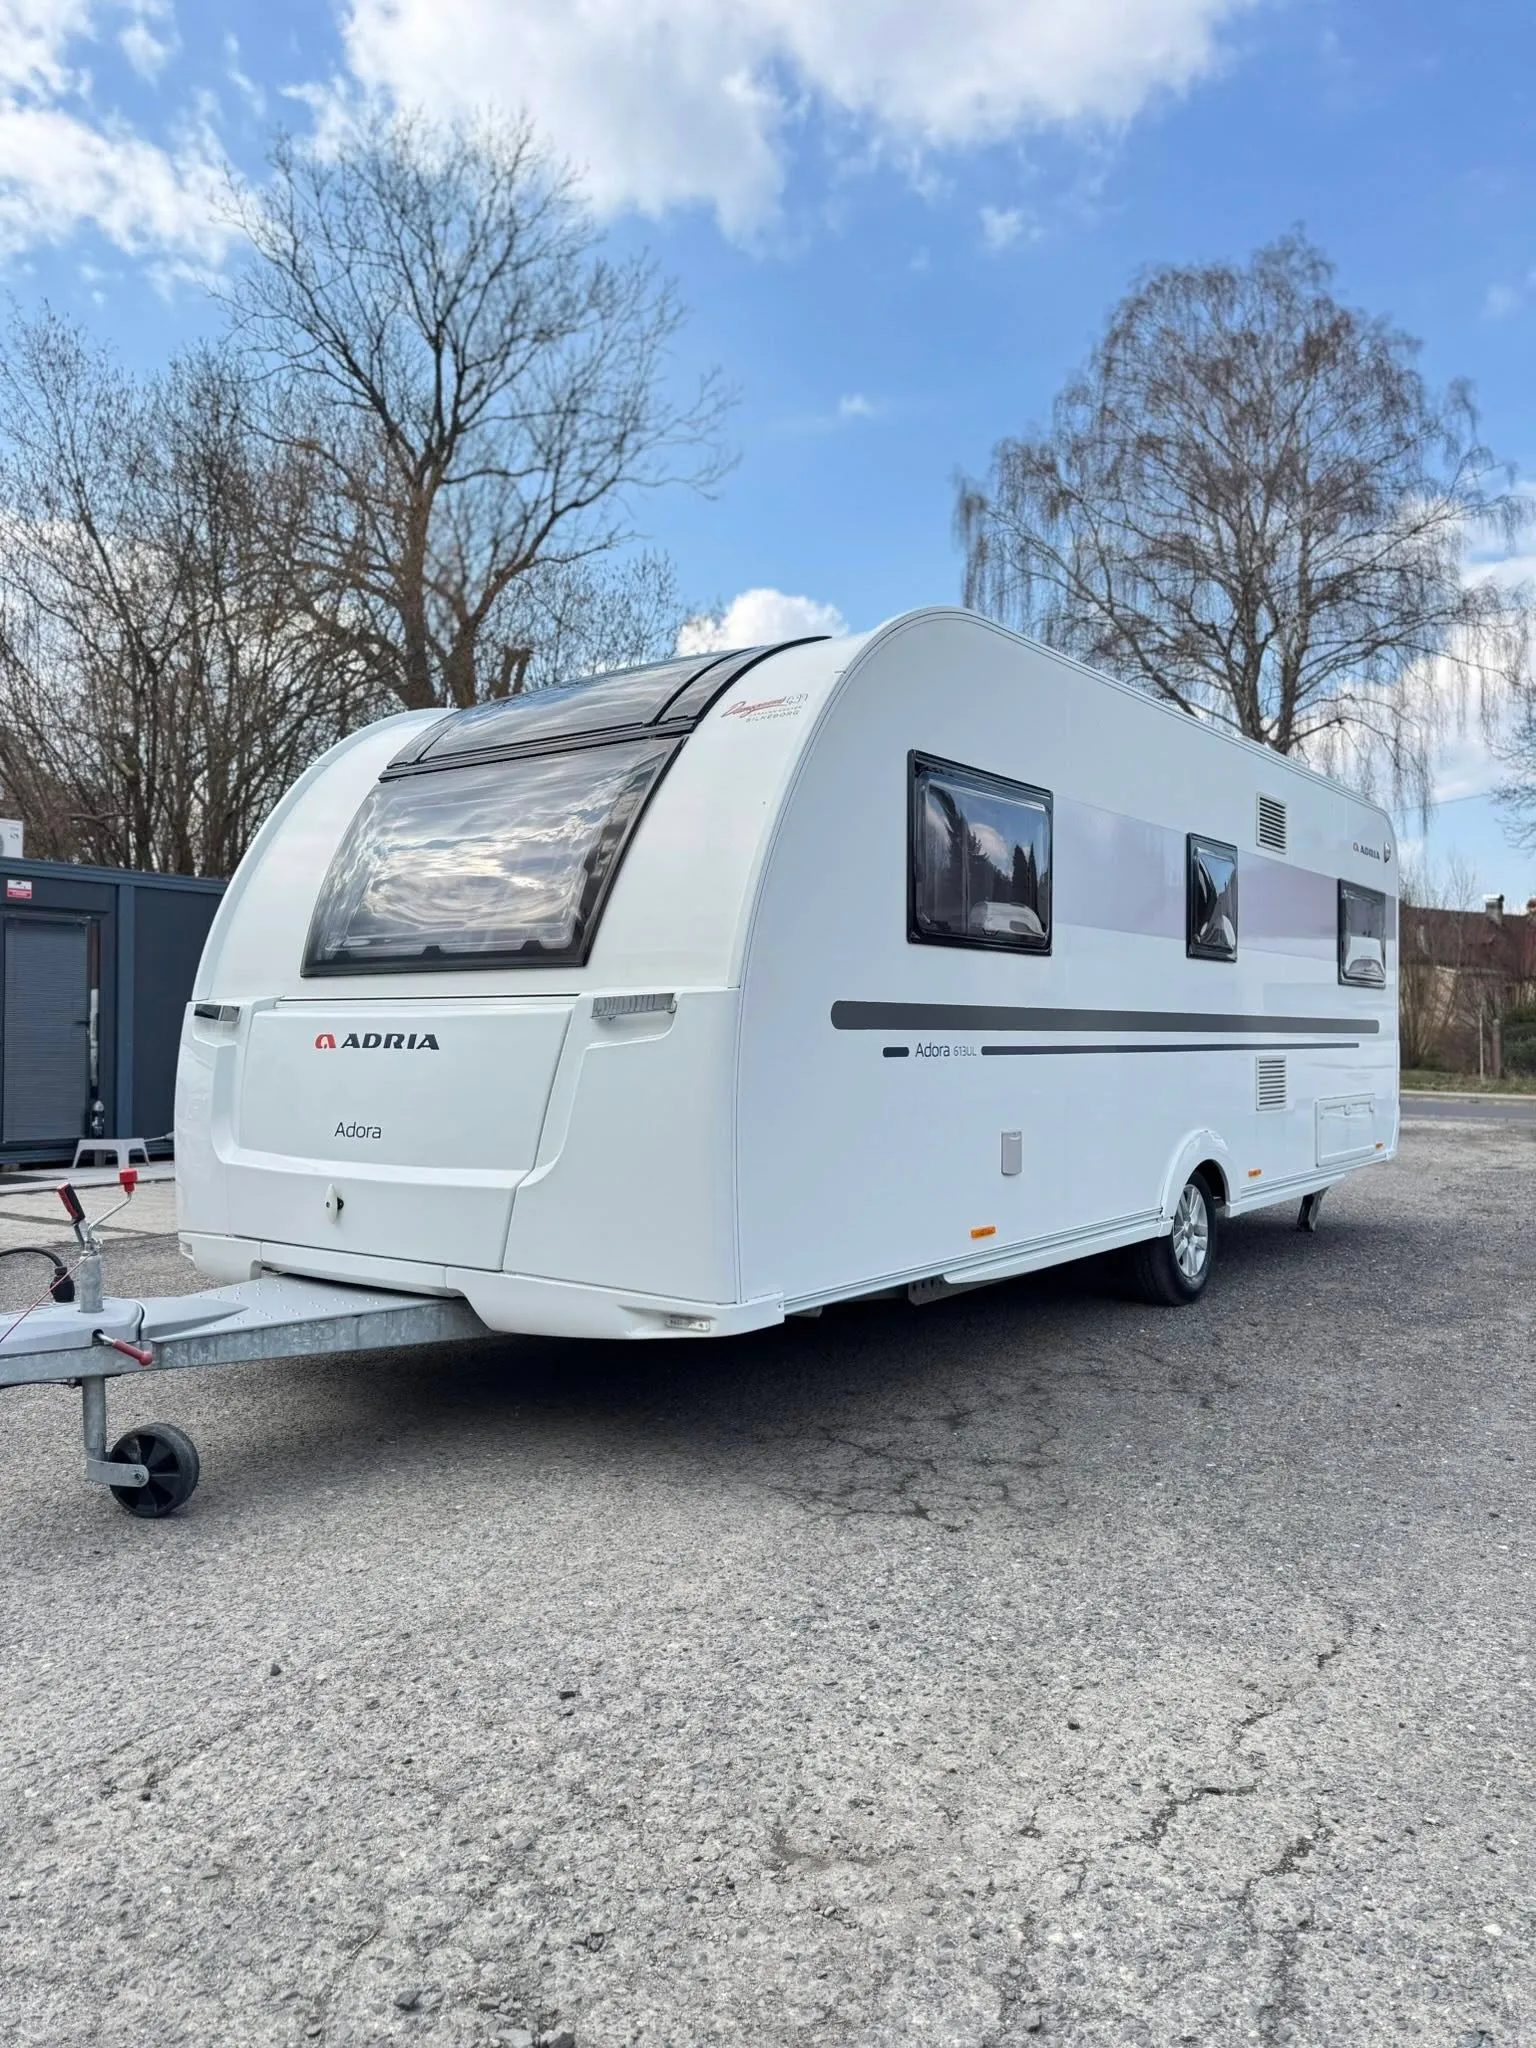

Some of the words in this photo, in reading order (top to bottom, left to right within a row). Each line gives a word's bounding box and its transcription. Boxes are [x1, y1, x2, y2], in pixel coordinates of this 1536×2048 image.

[340, 1033, 440, 1050] ADRIA
[915, 1042, 950, 1058] Adora
[953, 1046, 977, 1057] 613UL
[334, 1121, 382, 1139] Adora
